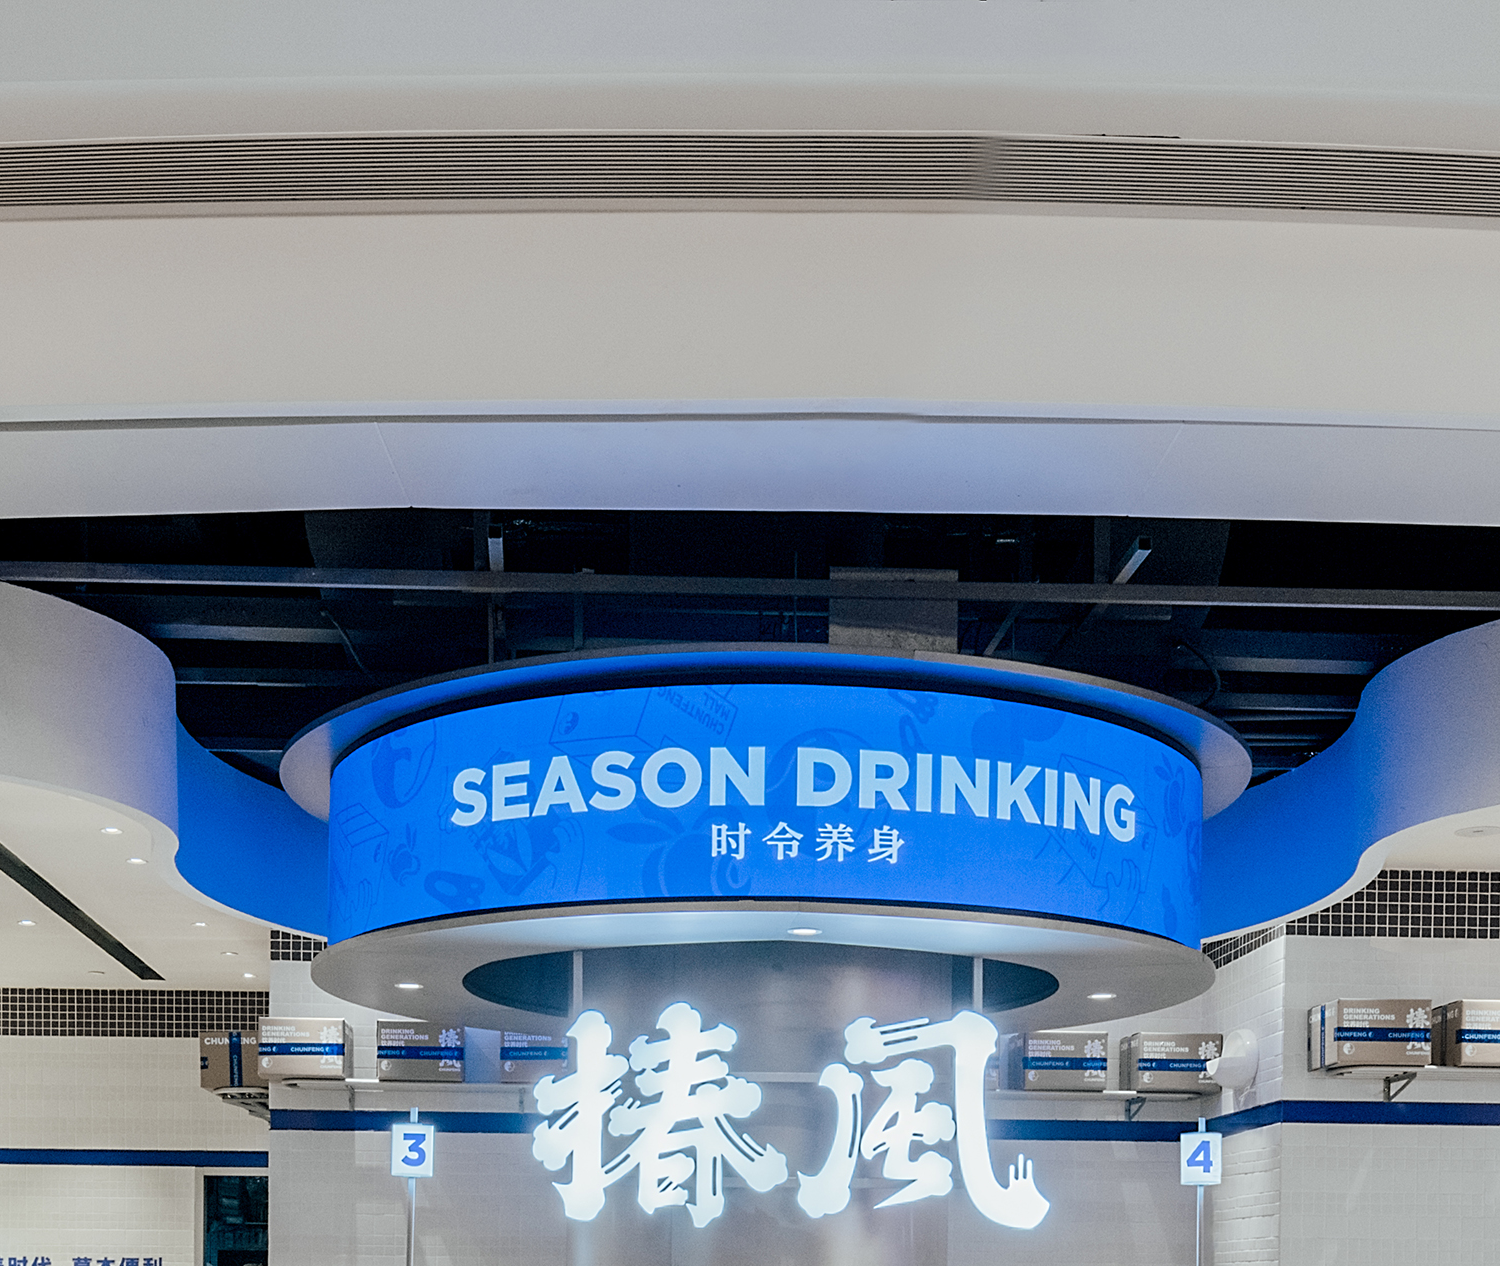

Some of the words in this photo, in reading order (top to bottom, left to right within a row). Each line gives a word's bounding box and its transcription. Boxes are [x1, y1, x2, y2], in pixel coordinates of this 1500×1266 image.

[450, 746, 766, 828] SEASON
[796, 747, 1137, 843] DRINKING
[711, 821, 905, 865] 时令养身
[402, 1133, 427, 1167] 3
[1186, 1140, 1213, 1173] 4
